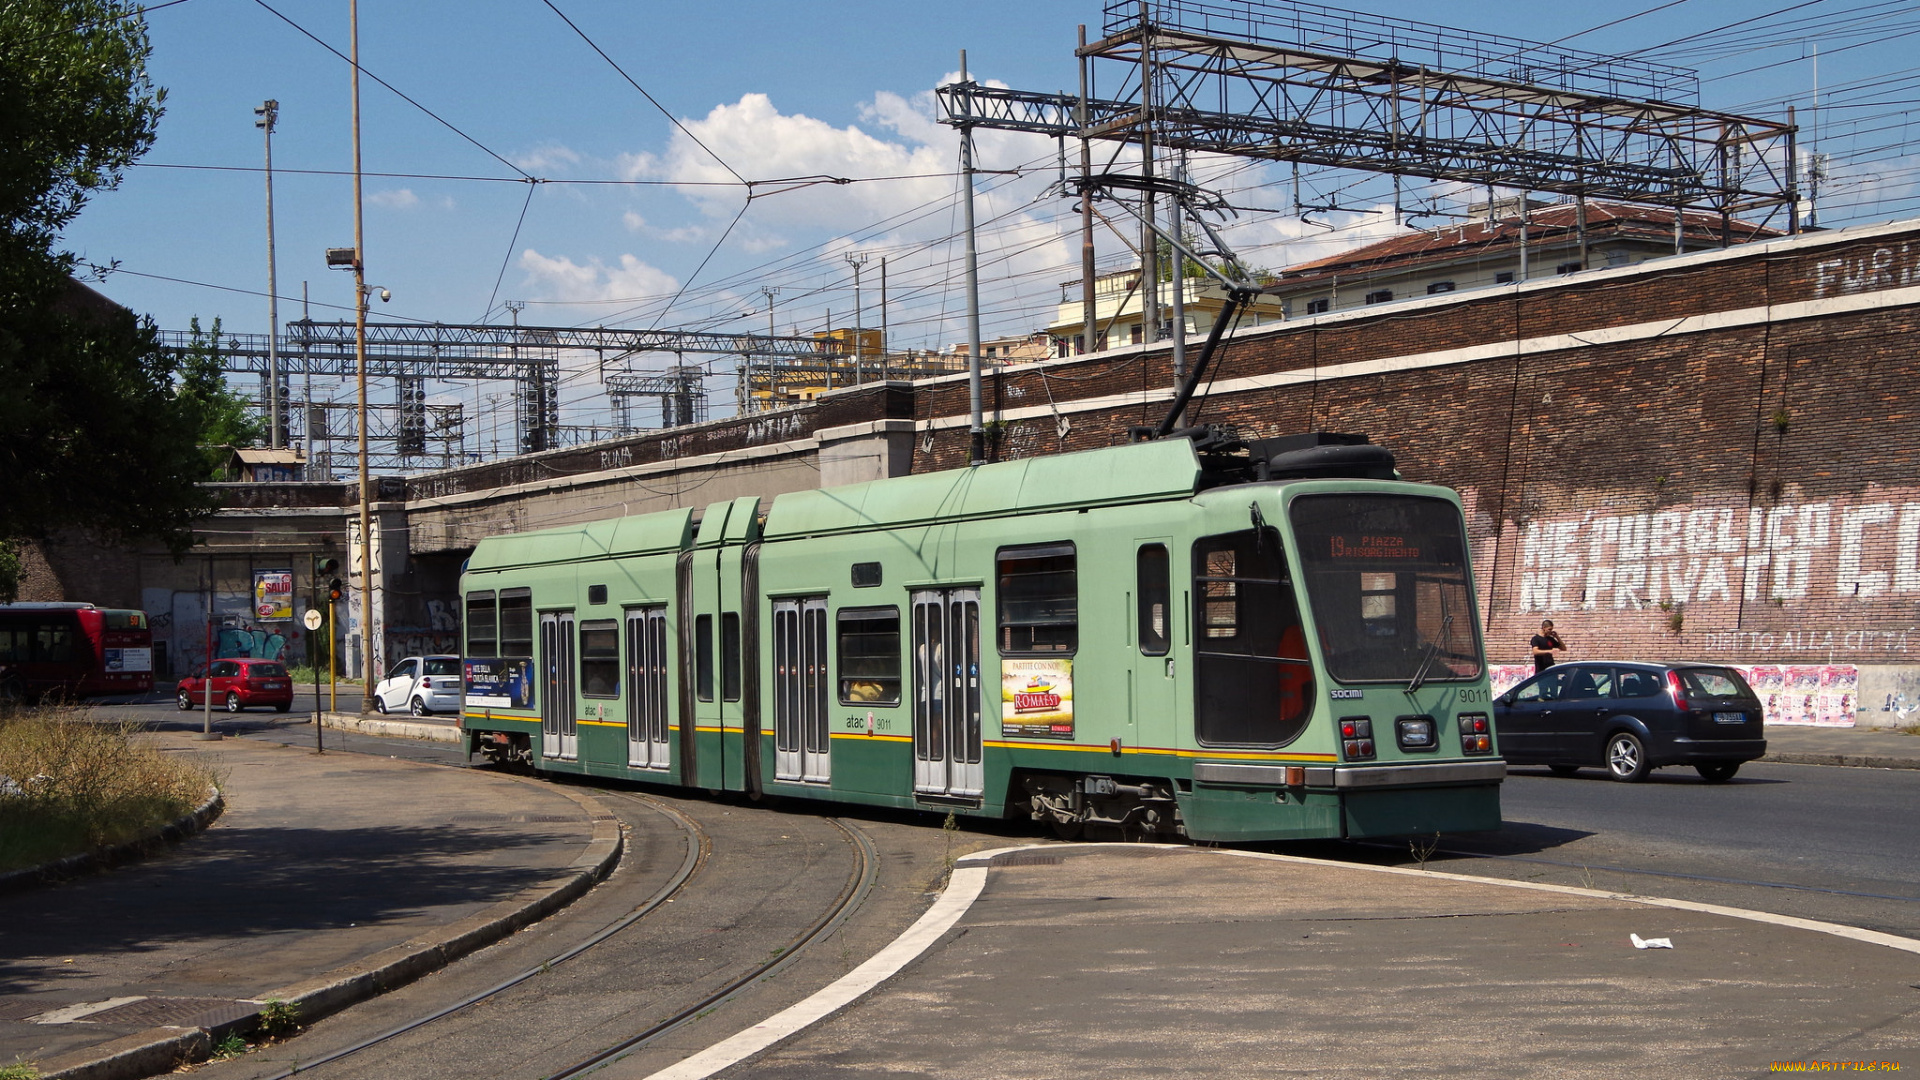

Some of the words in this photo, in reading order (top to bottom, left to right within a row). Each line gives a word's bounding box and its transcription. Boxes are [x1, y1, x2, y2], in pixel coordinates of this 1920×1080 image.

[1330, 535, 1344, 557] 19
[1361, 536, 1404, 546] PIAZZA
[1345, 547, 1419, 557] RISORGIMENTO
[265, 582, 291, 593] SALDI
[1580, 550, 1811, 611] PRIVATO
[1706, 632, 1774, 651] DIRITTO
[1779, 631, 1834, 651] ALLA
[1013, 661, 1033, 670] PARTITE
[1034, 661, 1047, 671] CON
[1015, 694, 1059, 708] ROMAEST
[1460, 689, 1488, 703] 9011
[846, 714, 864, 728] atac
[877, 718, 891, 730] 9011
